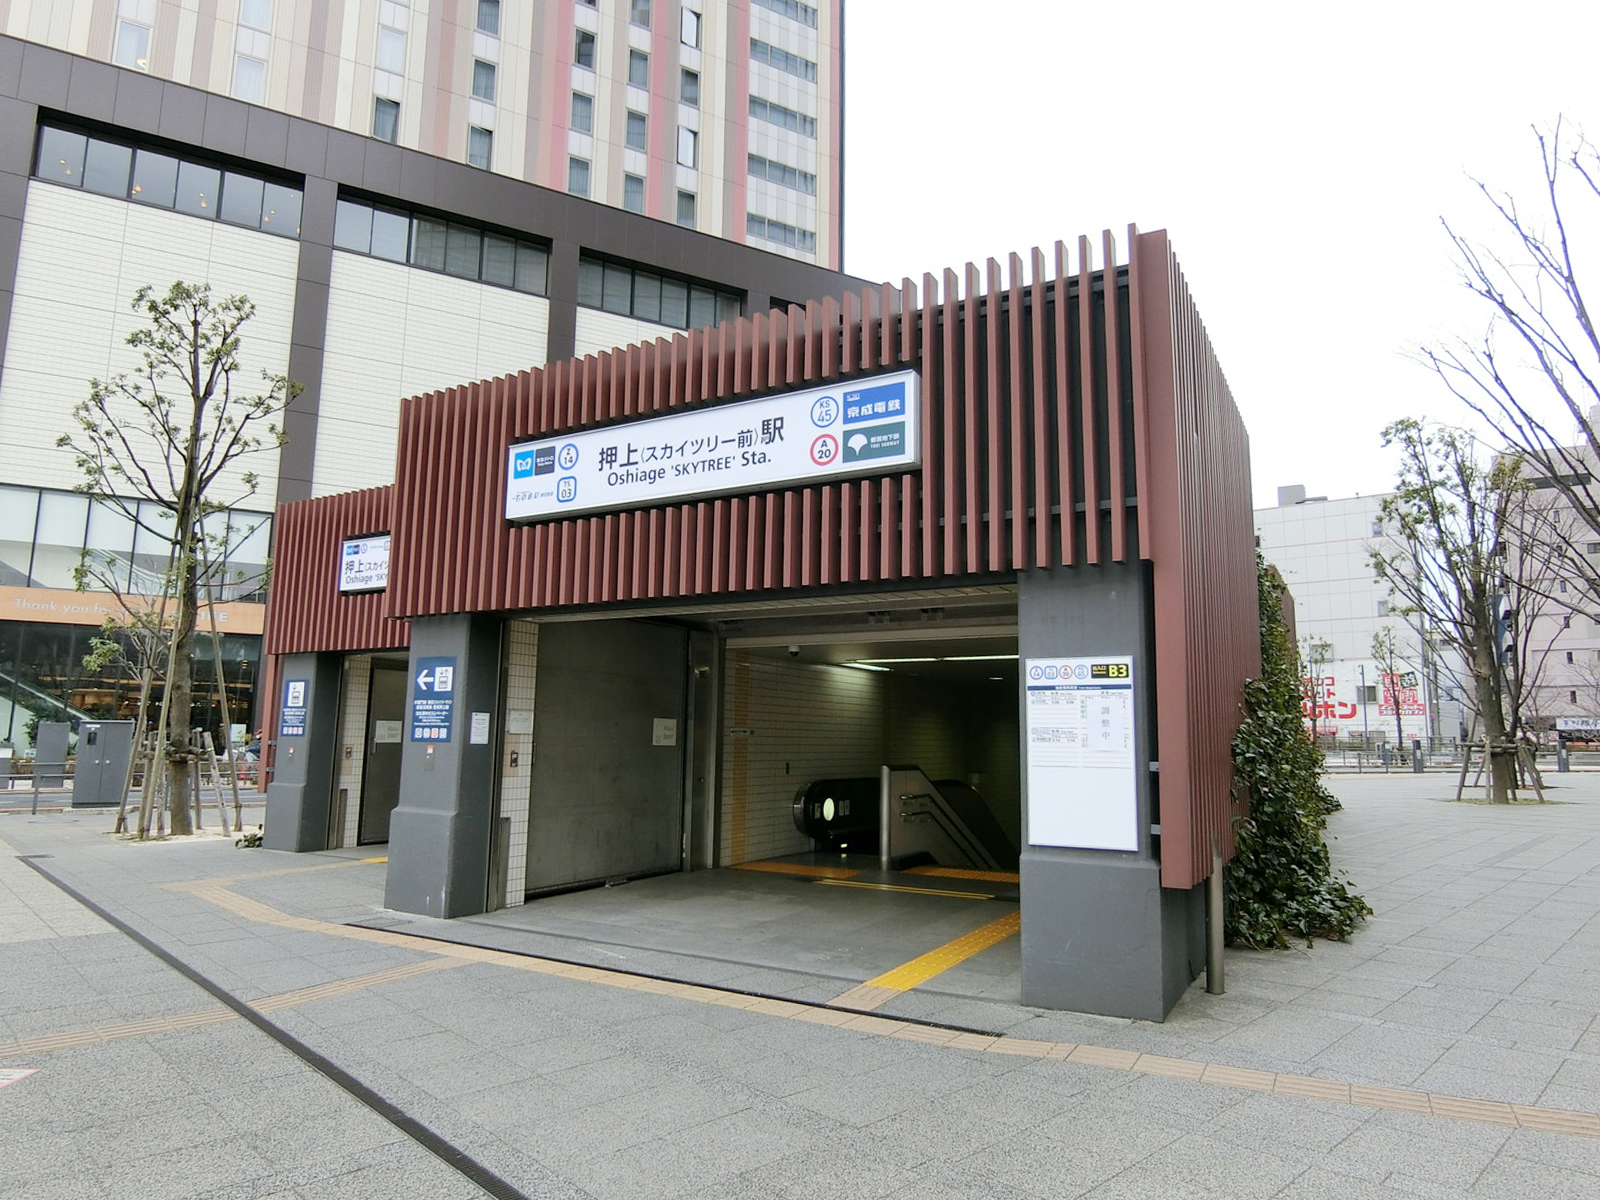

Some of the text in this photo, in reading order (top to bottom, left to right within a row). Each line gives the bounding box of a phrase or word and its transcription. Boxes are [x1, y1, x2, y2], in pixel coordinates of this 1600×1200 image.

[819, 400, 830, 409] KS
[847, 399, 901, 418] 京成電鉄
[817, 409, 832, 423] 45
[820, 439, 828, 448] A
[566, 448, 571, 456] Z
[817, 448, 832, 459] 20
[563, 456, 574, 465] 14
[607, 466, 666, 486] Oshiage
[741, 451, 772, 467] Sta.
[563, 480, 571, 488] TS
[561, 488, 572, 499] 03
[345, 573, 373, 585] Oshiage
[15, 598, 57, 611] Thank
[62, 603, 89, 614] you
[1108, 664, 1128, 677] B3
